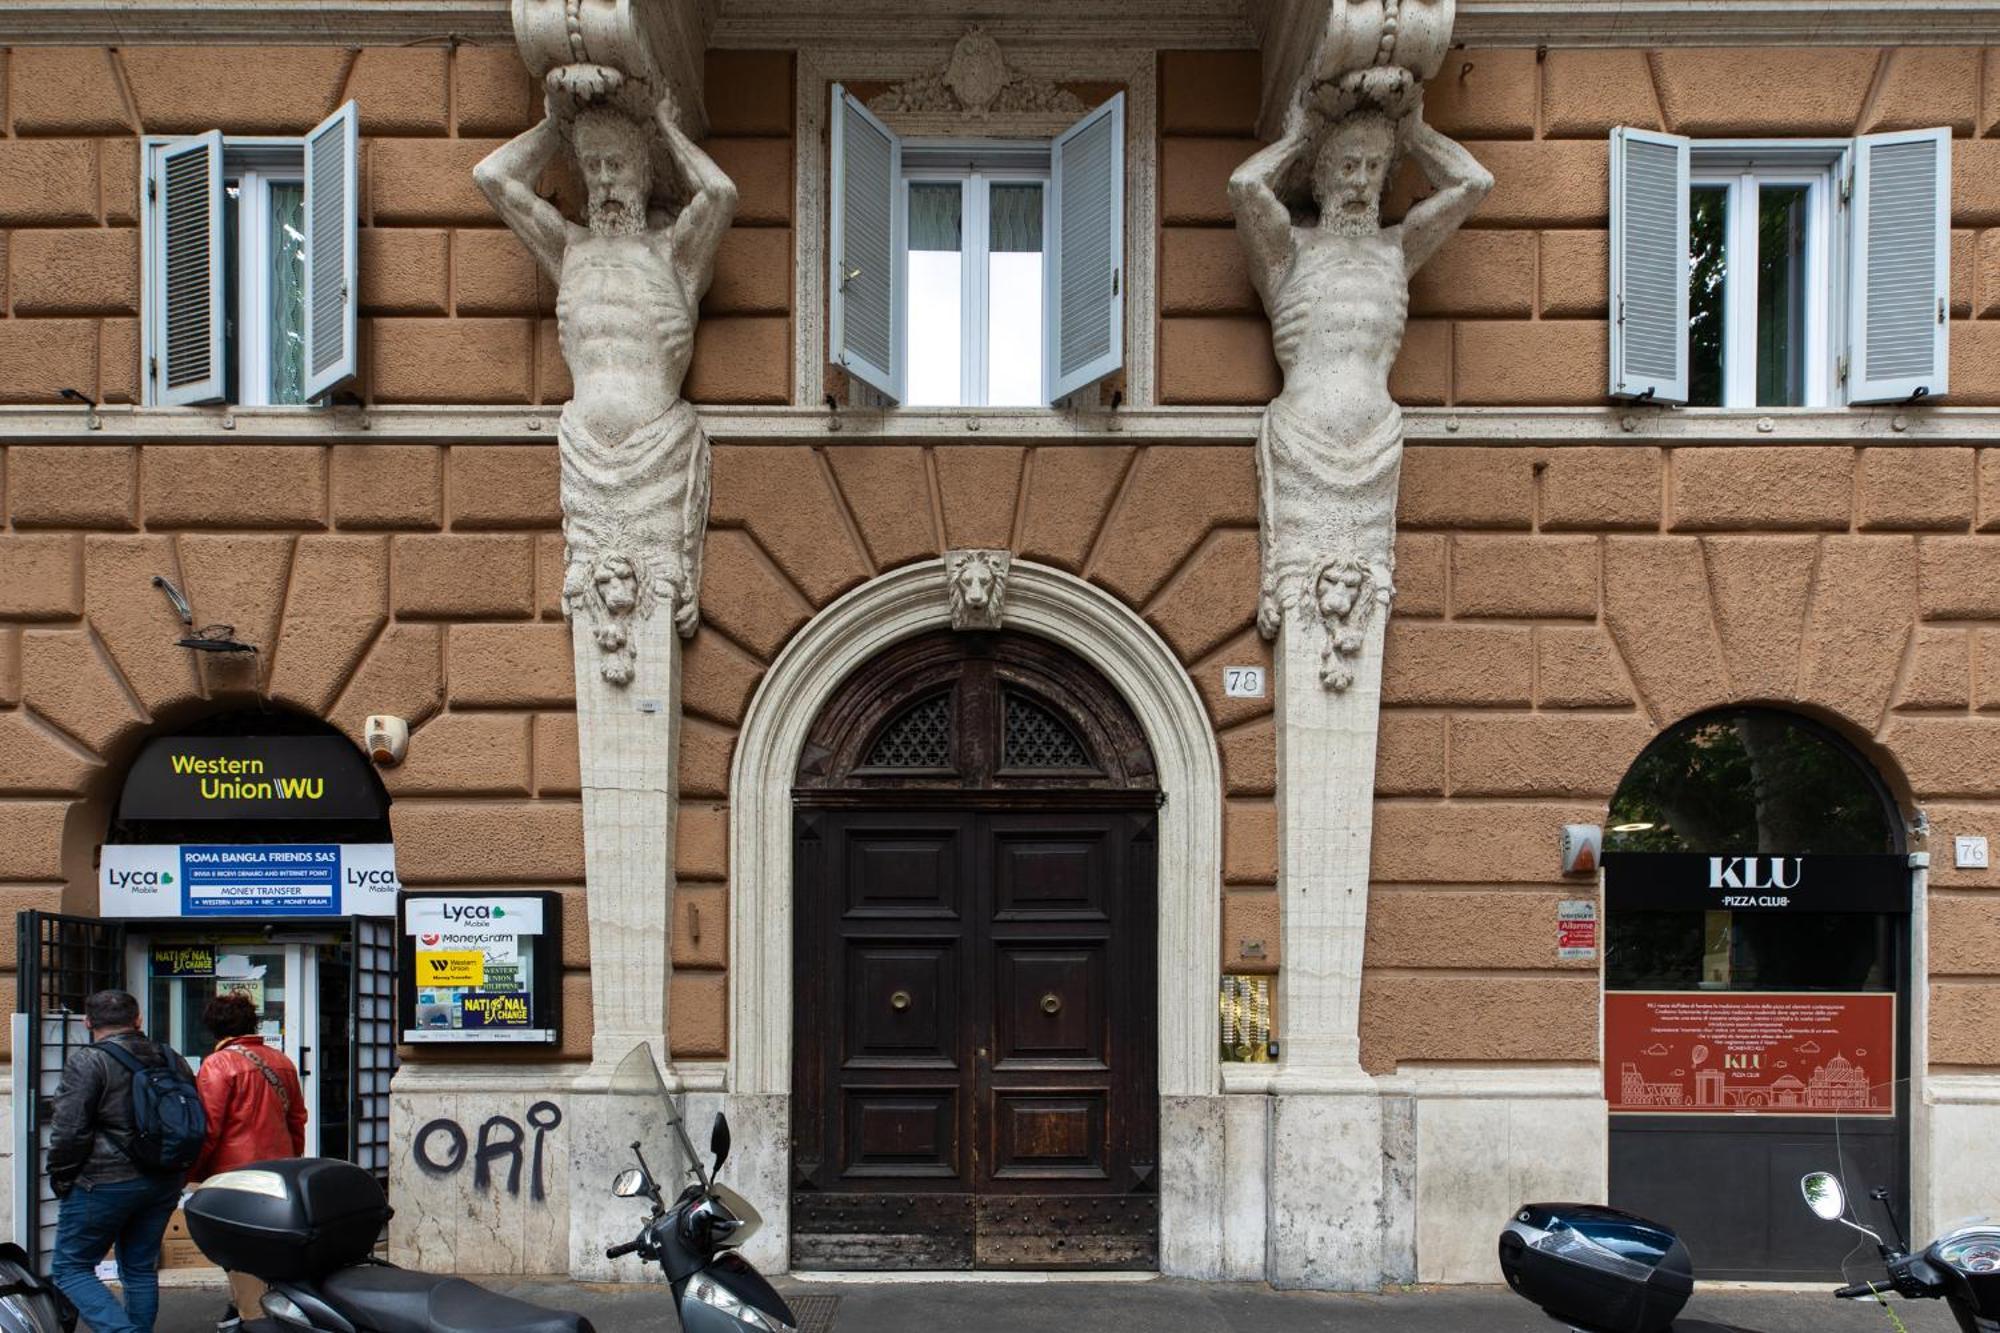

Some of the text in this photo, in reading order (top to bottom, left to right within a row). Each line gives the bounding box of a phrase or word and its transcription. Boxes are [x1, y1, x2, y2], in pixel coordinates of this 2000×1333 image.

[1229, 671, 1258, 691] 78
[171, 755, 264, 774] Western
[200, 777, 272, 799] Union
[185, 853, 336, 862] ROMA BANGLA FRIENDS SAS
[1960, 844, 1984, 860] 76
[109, 868, 158, 888] Lyca
[347, 867, 395, 887] Lyca
[1709, 856, 1803, 889] KLU
[131, 886, 158, 894] Mobile
[220, 887, 302, 895] MONEY TRANSFER
[368, 885, 395, 893] Mobile
[443, 903, 490, 922] Lyca
[464, 920, 490, 928] Mobile
[442, 933, 513, 945] MoneyGram
